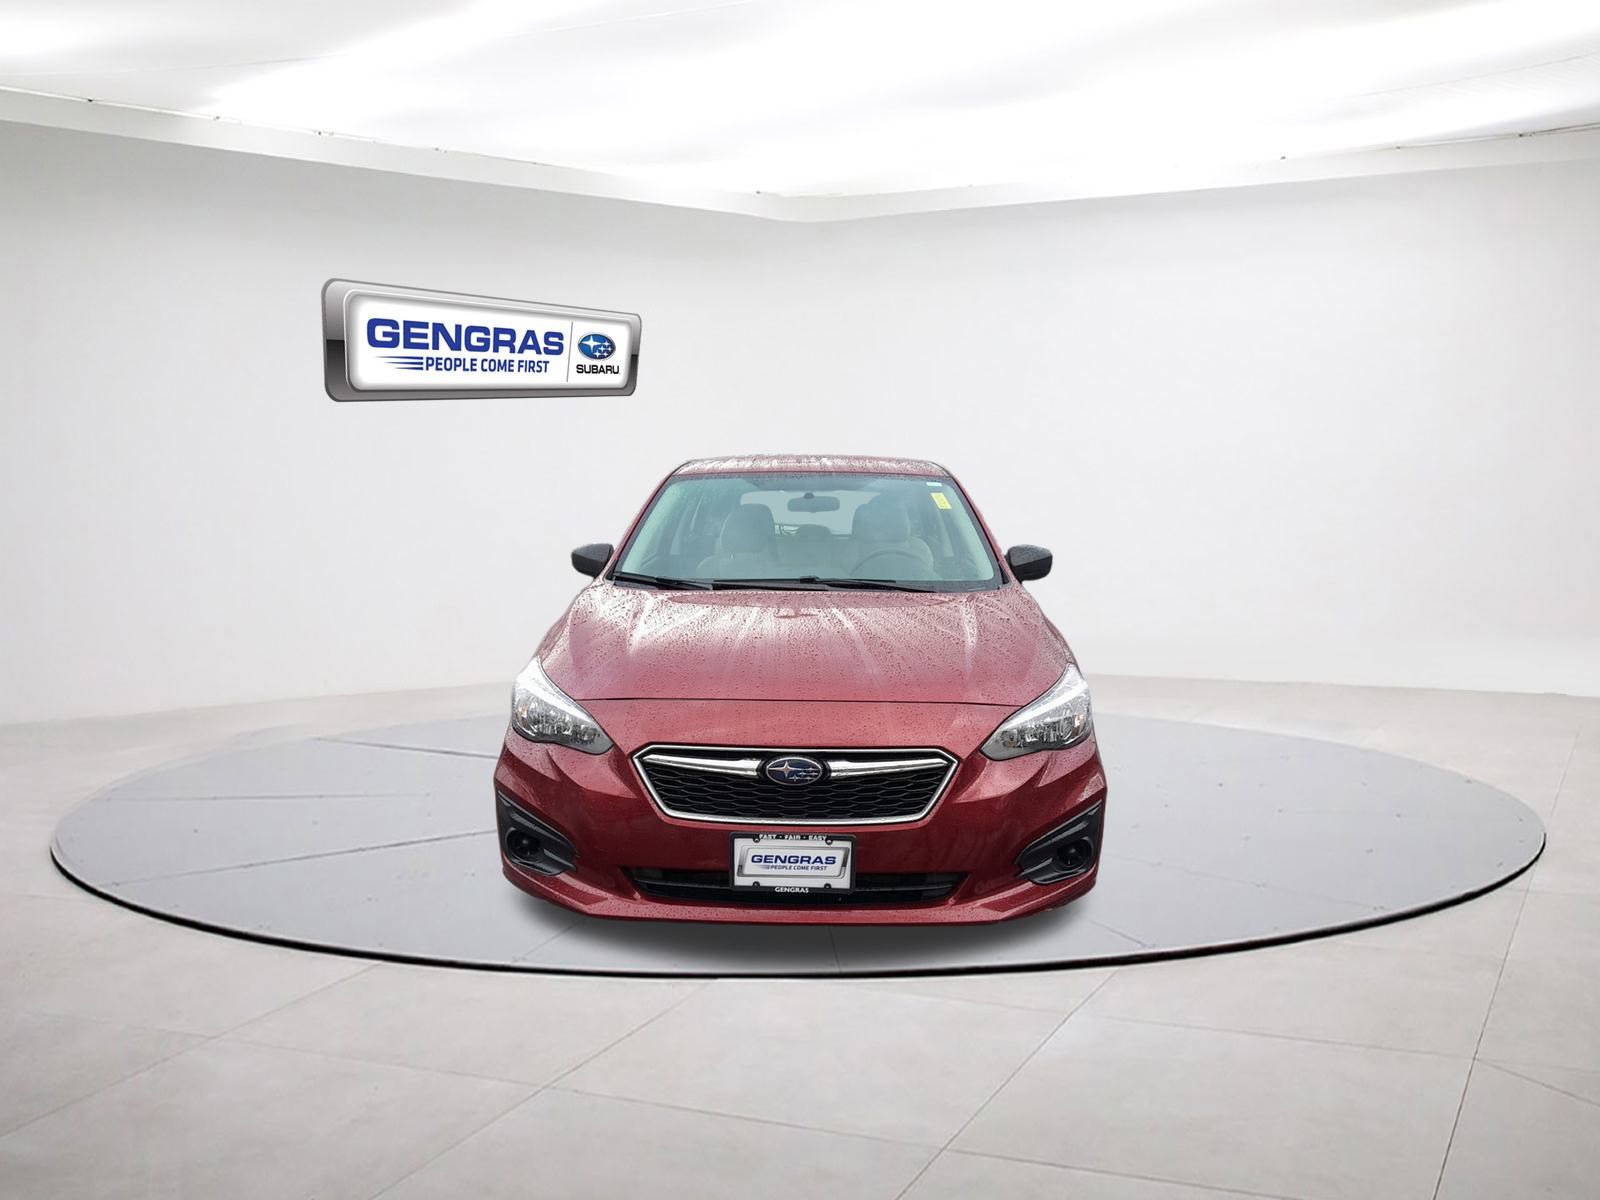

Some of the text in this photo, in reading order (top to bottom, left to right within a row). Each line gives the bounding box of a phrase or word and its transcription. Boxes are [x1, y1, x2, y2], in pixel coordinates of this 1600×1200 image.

[366, 317, 565, 356] GENGRAS
[425, 356, 550, 374] PEOPLE COME FIRST
[576, 363, 620, 375] SUBARU
[751, 854, 837, 865] GENGRAS
